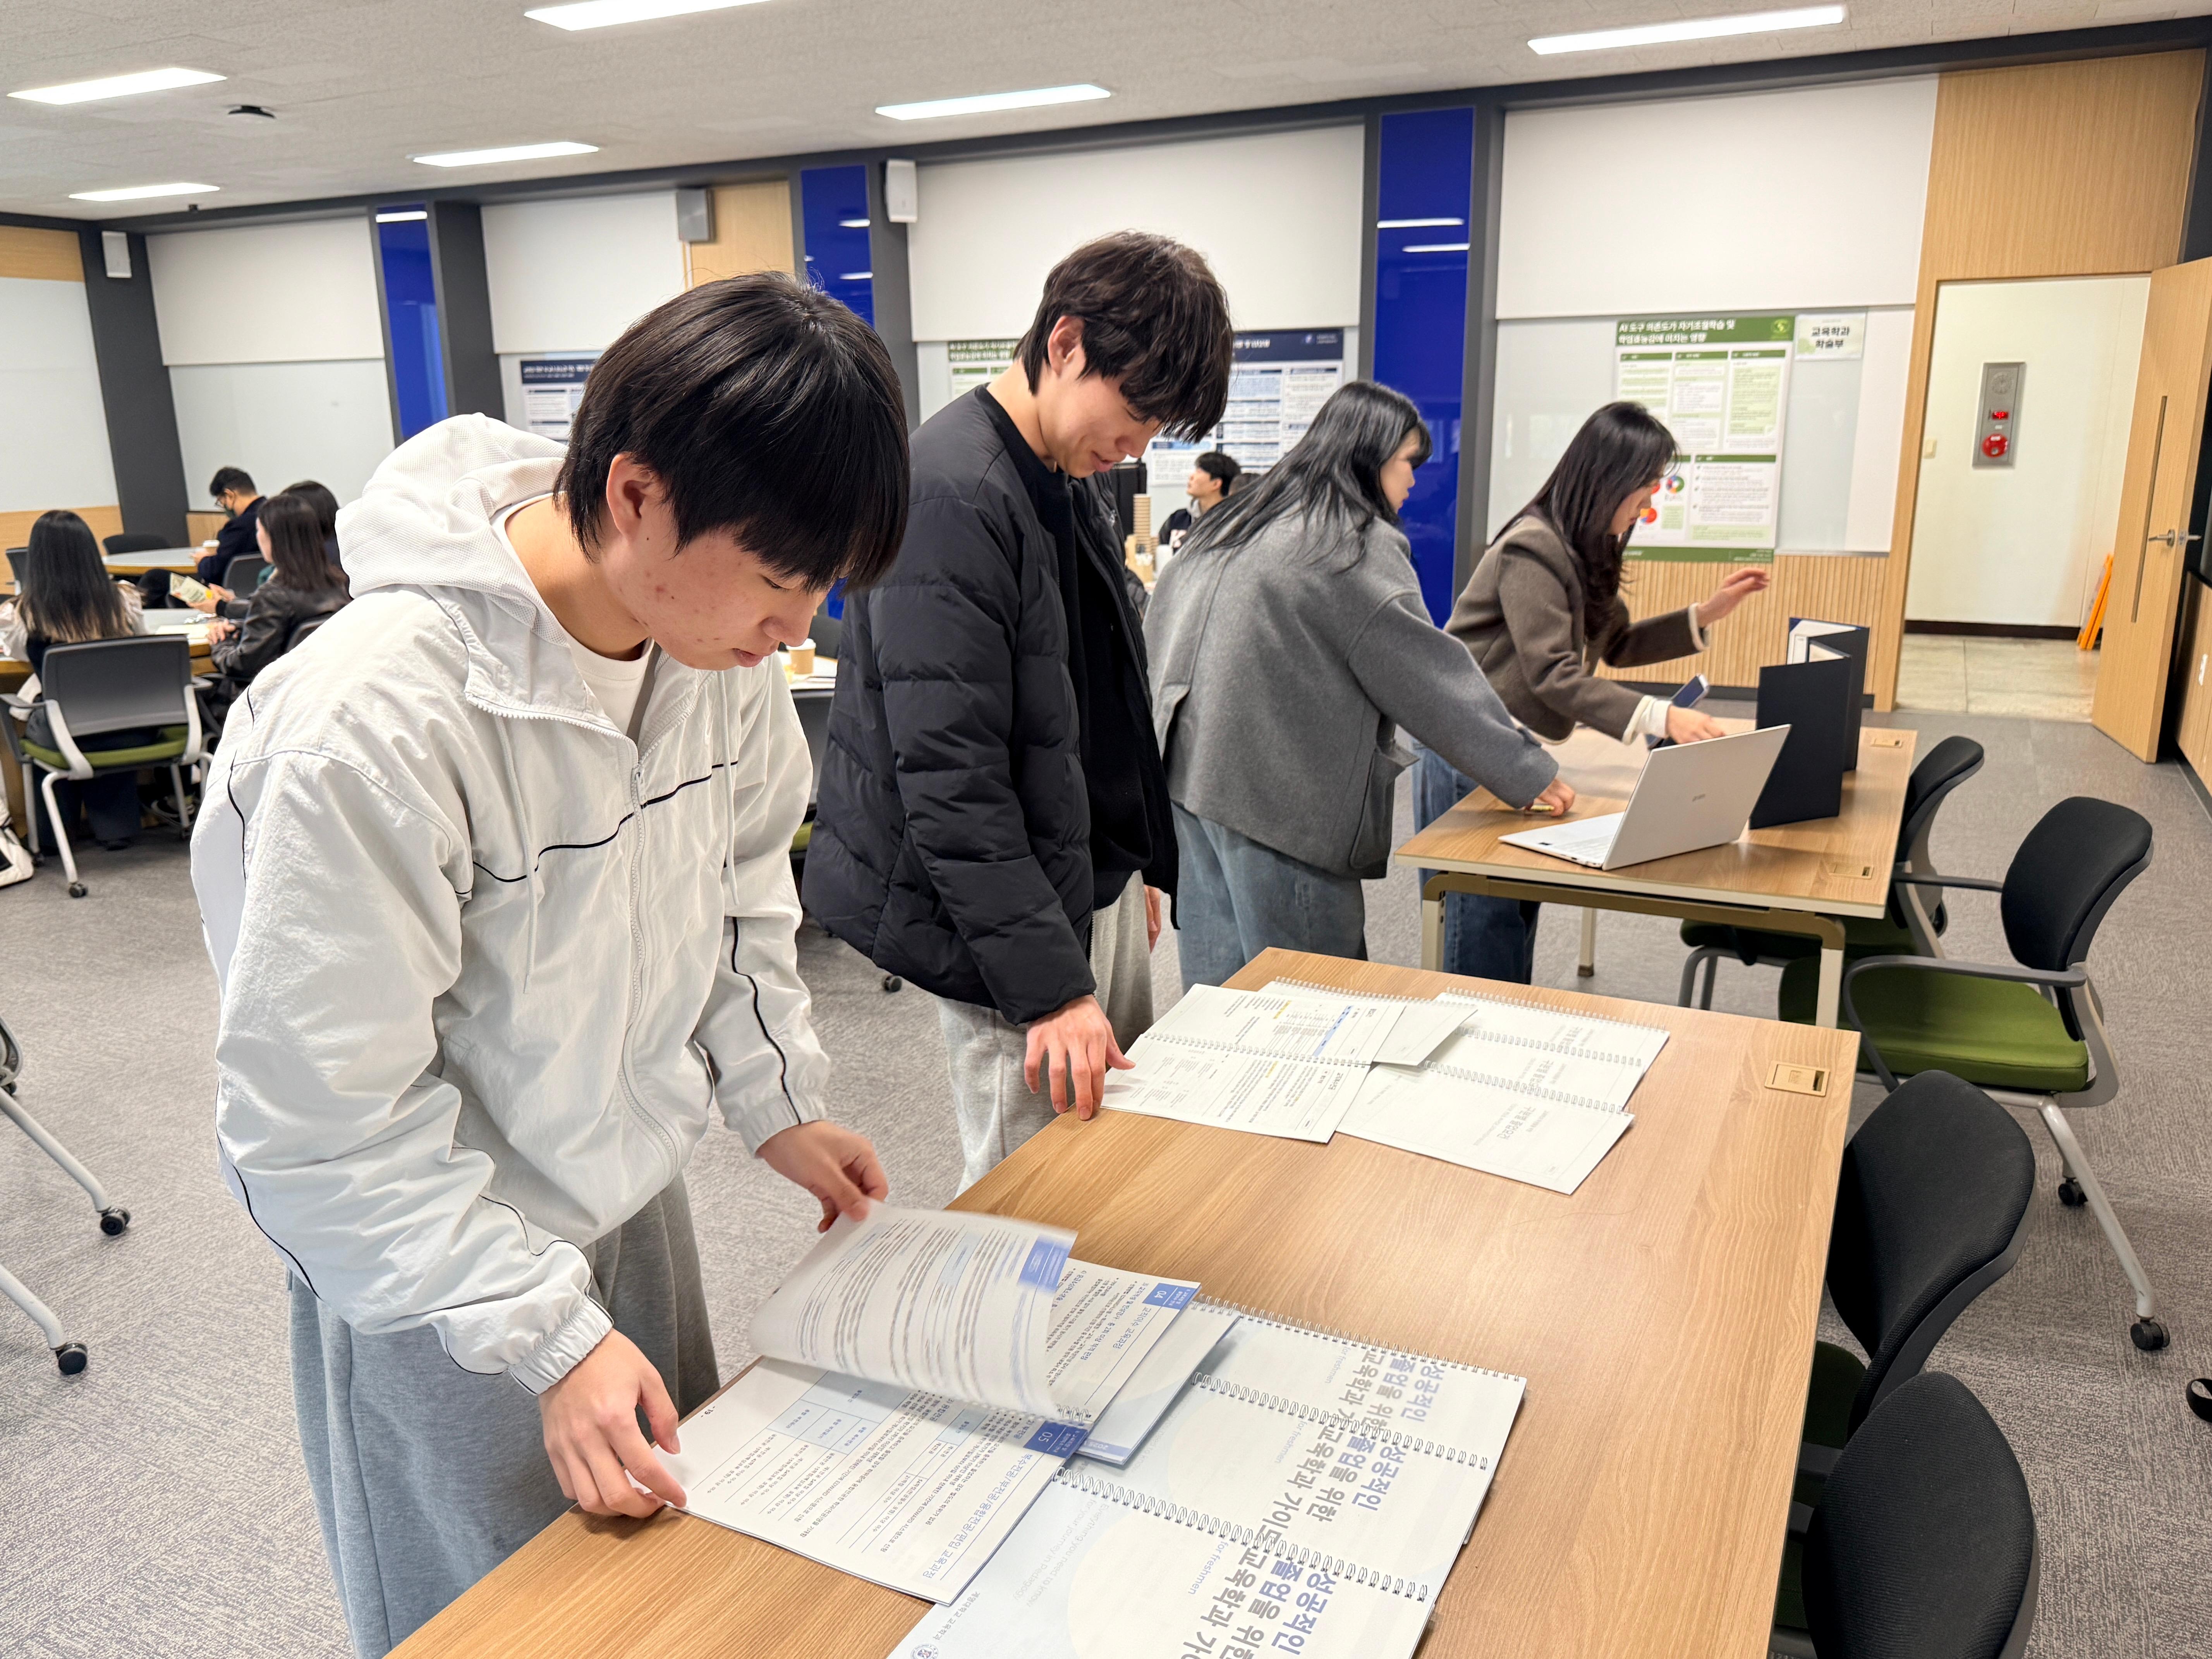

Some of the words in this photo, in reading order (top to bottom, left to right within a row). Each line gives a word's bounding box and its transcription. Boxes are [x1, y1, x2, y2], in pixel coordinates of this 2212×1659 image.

[1812, 326, 1850, 337] 교육학과
[1131, 1307, 1151, 1326] 교직이수
[1113, 1328, 1134, 1348] 교육과정
[1340, 1346, 1352, 1355] for
[1324, 1355, 1346, 1383] freshmen
[1339, 1350, 1384, 1405] 교육학과
[1377, 1356, 1415, 1399] 졸업을
[1401, 1362, 1443, 1421] 성공적인
[929, 1404, 950, 1422] 융합전공
[1296, 1420, 1307, 1431] for
[1013, 1426, 1029, 1439] 부전공
[1038, 1432, 1052, 1442] 05
[1274, 1431, 1301, 1463] freshmen
[1288, 1426, 1342, 1488] 교육학과
[1329, 1436, 1375, 1482] 졸업을
[1353, 1443, 1405, 1510] 성공적인
[949, 1454, 1031, 1548] 복수전공/부전공/융합전공/편입
[1085, 1498, 1097, 1510] for
[1307, 1487, 1344, 1521] 위한
[1072, 1508, 1087, 1527] your
[1075, 1501, 1110, 1542] Everything
[1049, 1525, 1076, 1555] journey
[1065, 1540, 1082, 1556] you
[1215, 1541, 1228, 1553] for
[922, 1549, 953, 1578] 교육과정
[1042, 1554, 1055, 1563] in
[1049, 1556, 1070, 1577] need
[1013, 1563, 1048, 1604] Pedagogy
[1042, 1576, 1053, 1585] to
[1188, 1554, 1220, 1594] freshmen
[1202, 1548, 1266, 1626] 교육학과
[953, 1588, 980, 1617] 계명대학교
[1026, 1584, 1048, 1607] know
[1249, 1561, 1302, 1619] 졸업을
[1273, 1573, 1335, 1654] 성공적인
[933, 1618, 956, 1640] 교육학과
